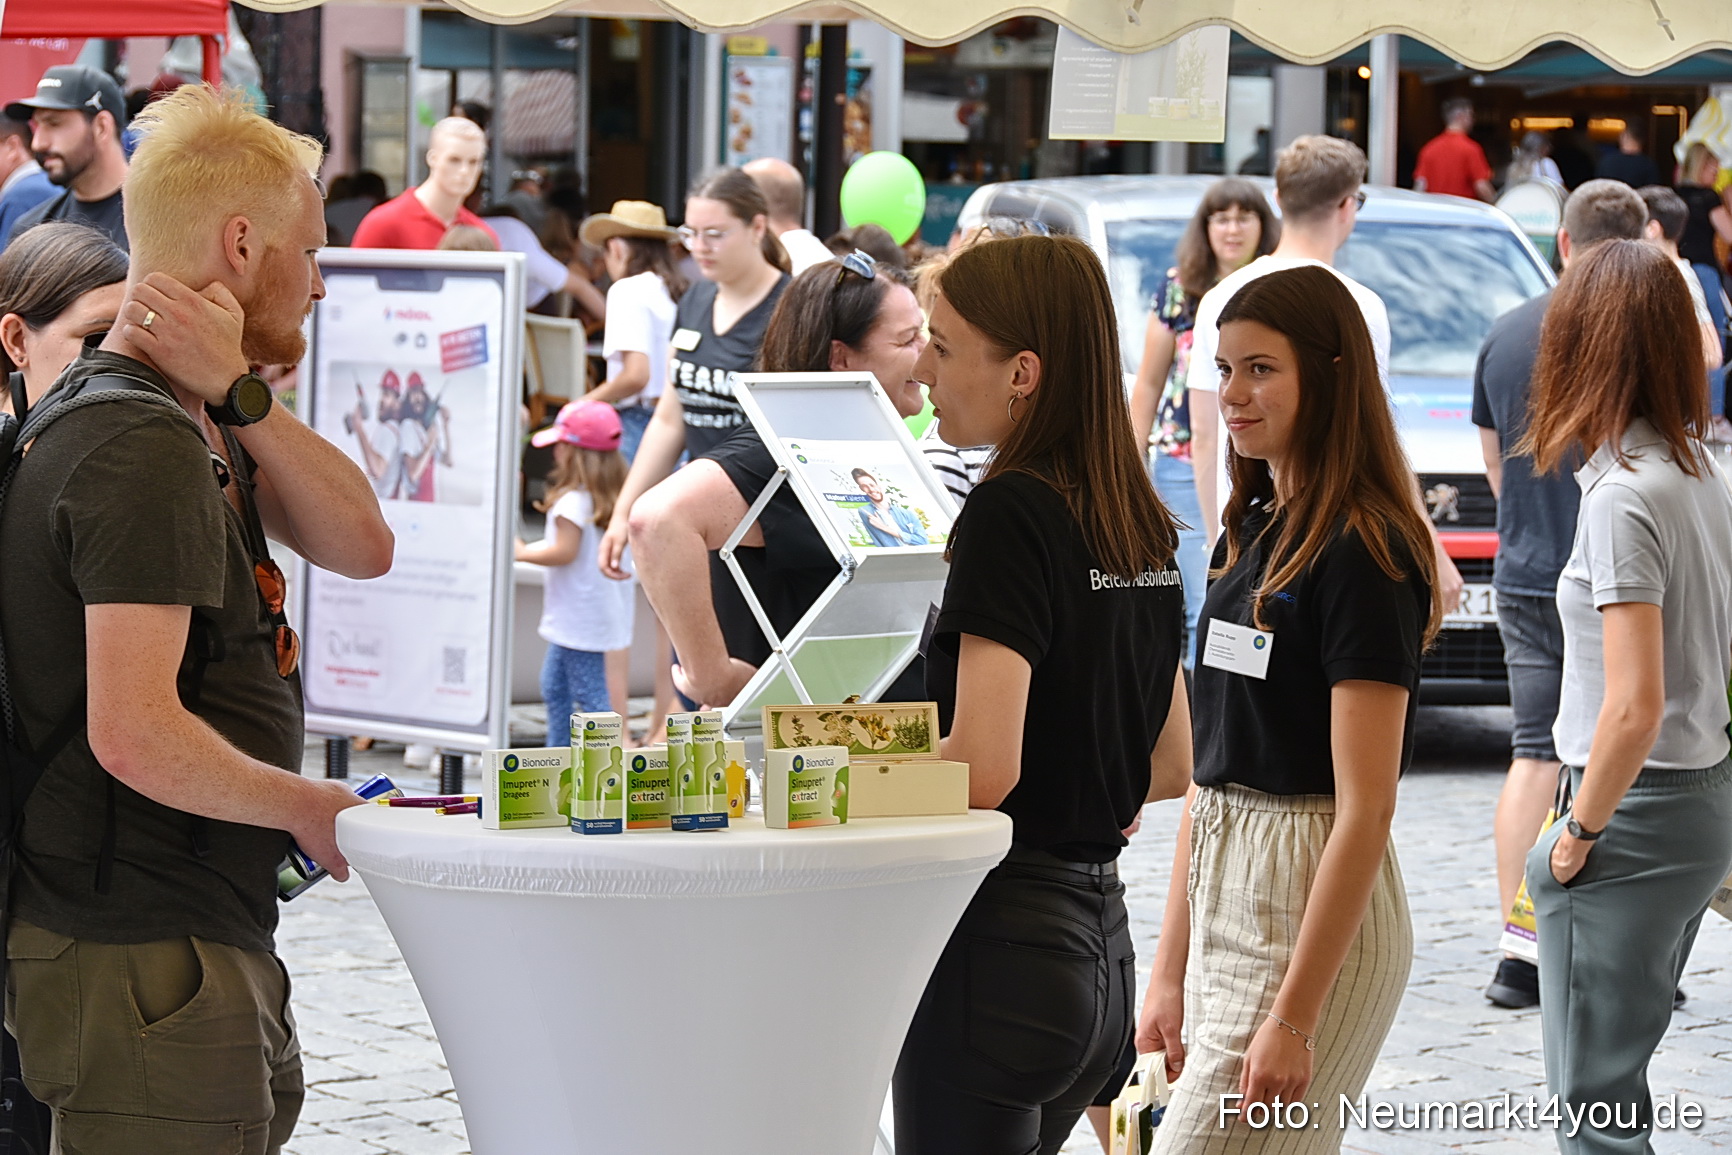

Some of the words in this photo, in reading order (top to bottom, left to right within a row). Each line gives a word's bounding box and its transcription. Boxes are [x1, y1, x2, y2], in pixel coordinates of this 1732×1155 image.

[542, 779, 549, 787] N
[503, 791, 530, 800] Dragees
[631, 791, 665, 802] extract
[792, 791, 817, 802] extract
